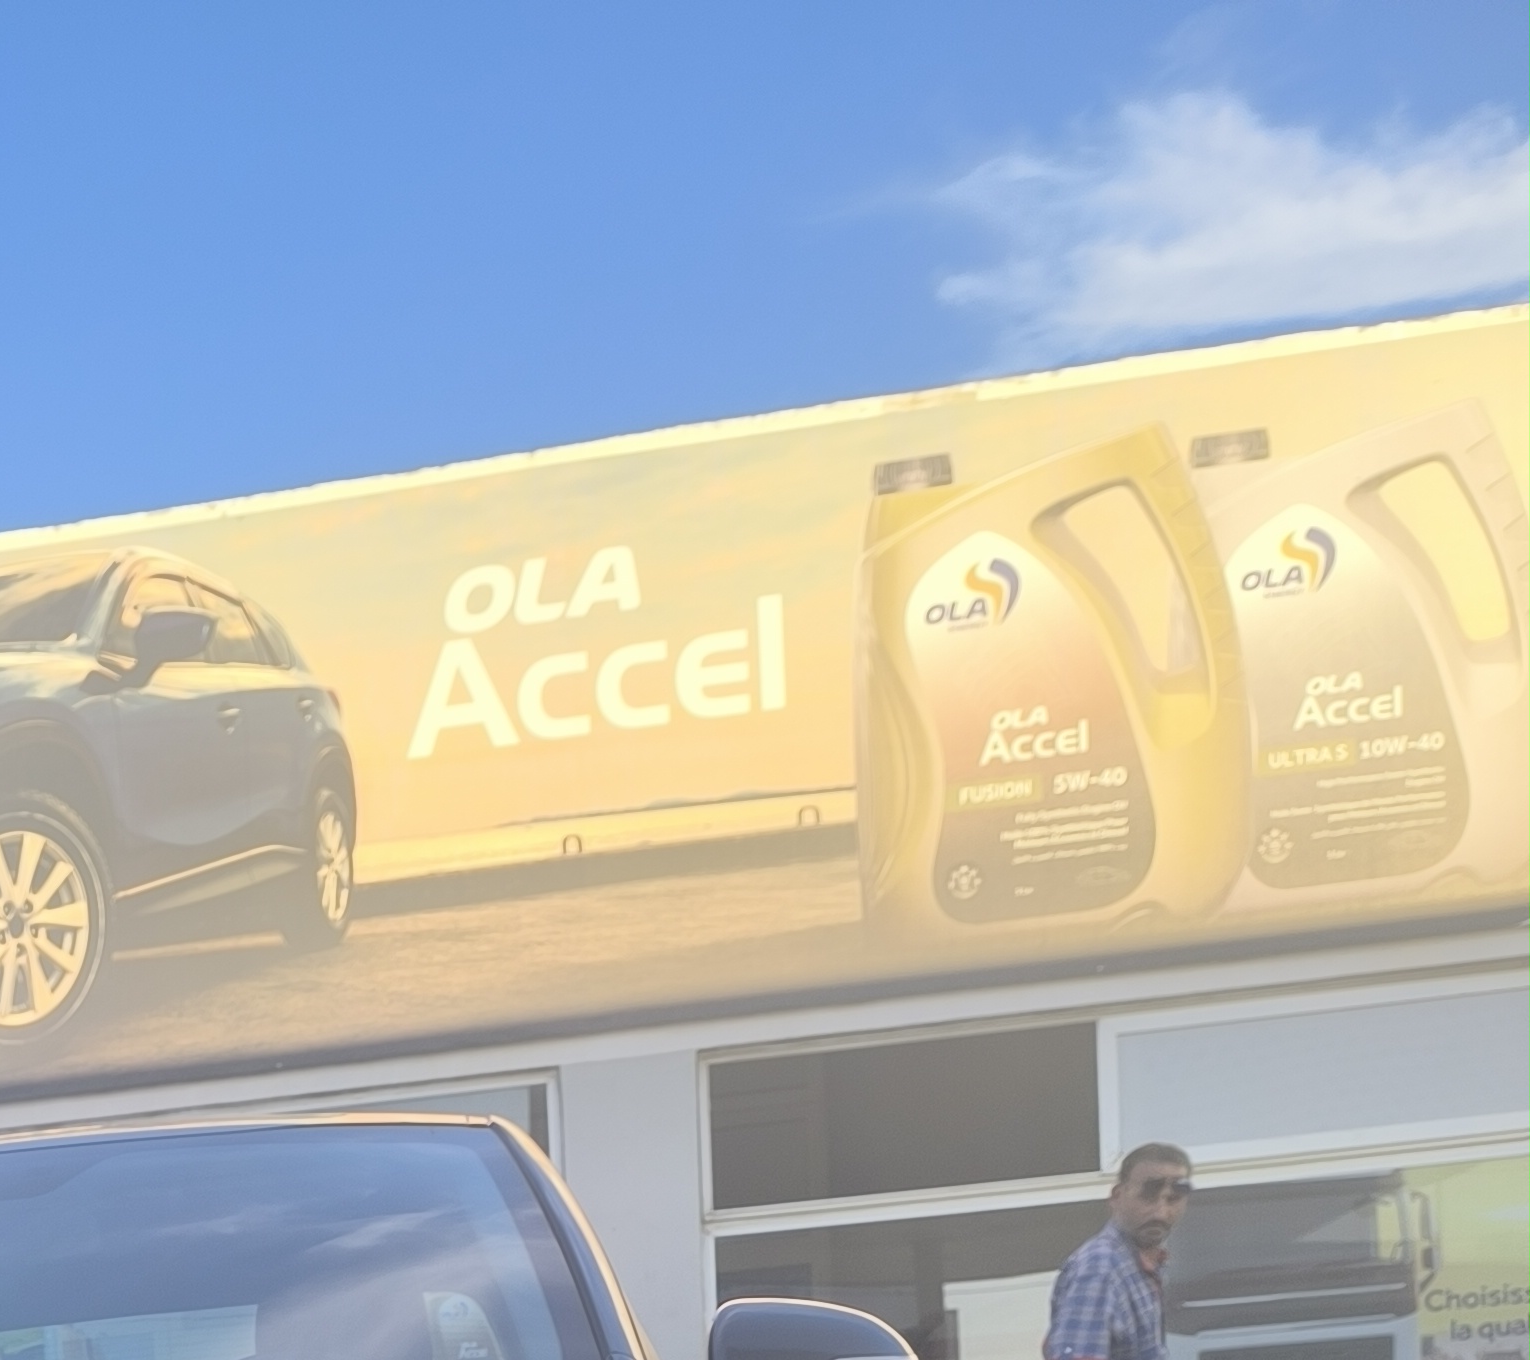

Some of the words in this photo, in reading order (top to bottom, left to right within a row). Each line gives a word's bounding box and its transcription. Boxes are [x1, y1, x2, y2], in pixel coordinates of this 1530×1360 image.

[444, 545, 641, 633] OLA
[1240, 565, 1304, 592] OLA
[925, 598, 988, 625] OLA
[407, 593, 786, 760] Accel
[1304, 671, 1364, 697] OLA
[990, 705, 1050, 730] OLA
[1292, 685, 1404, 731] Accel
[978, 718, 1090, 767] Accel
[1267, 746, 1333, 770] ULTRA
[1335, 743, 1350, 762] S
[1359, 731, 1446, 760] 10W-40
[958, 778, 1033, 806] FUSION
[1053, 766, 1129, 795] 5W-40
